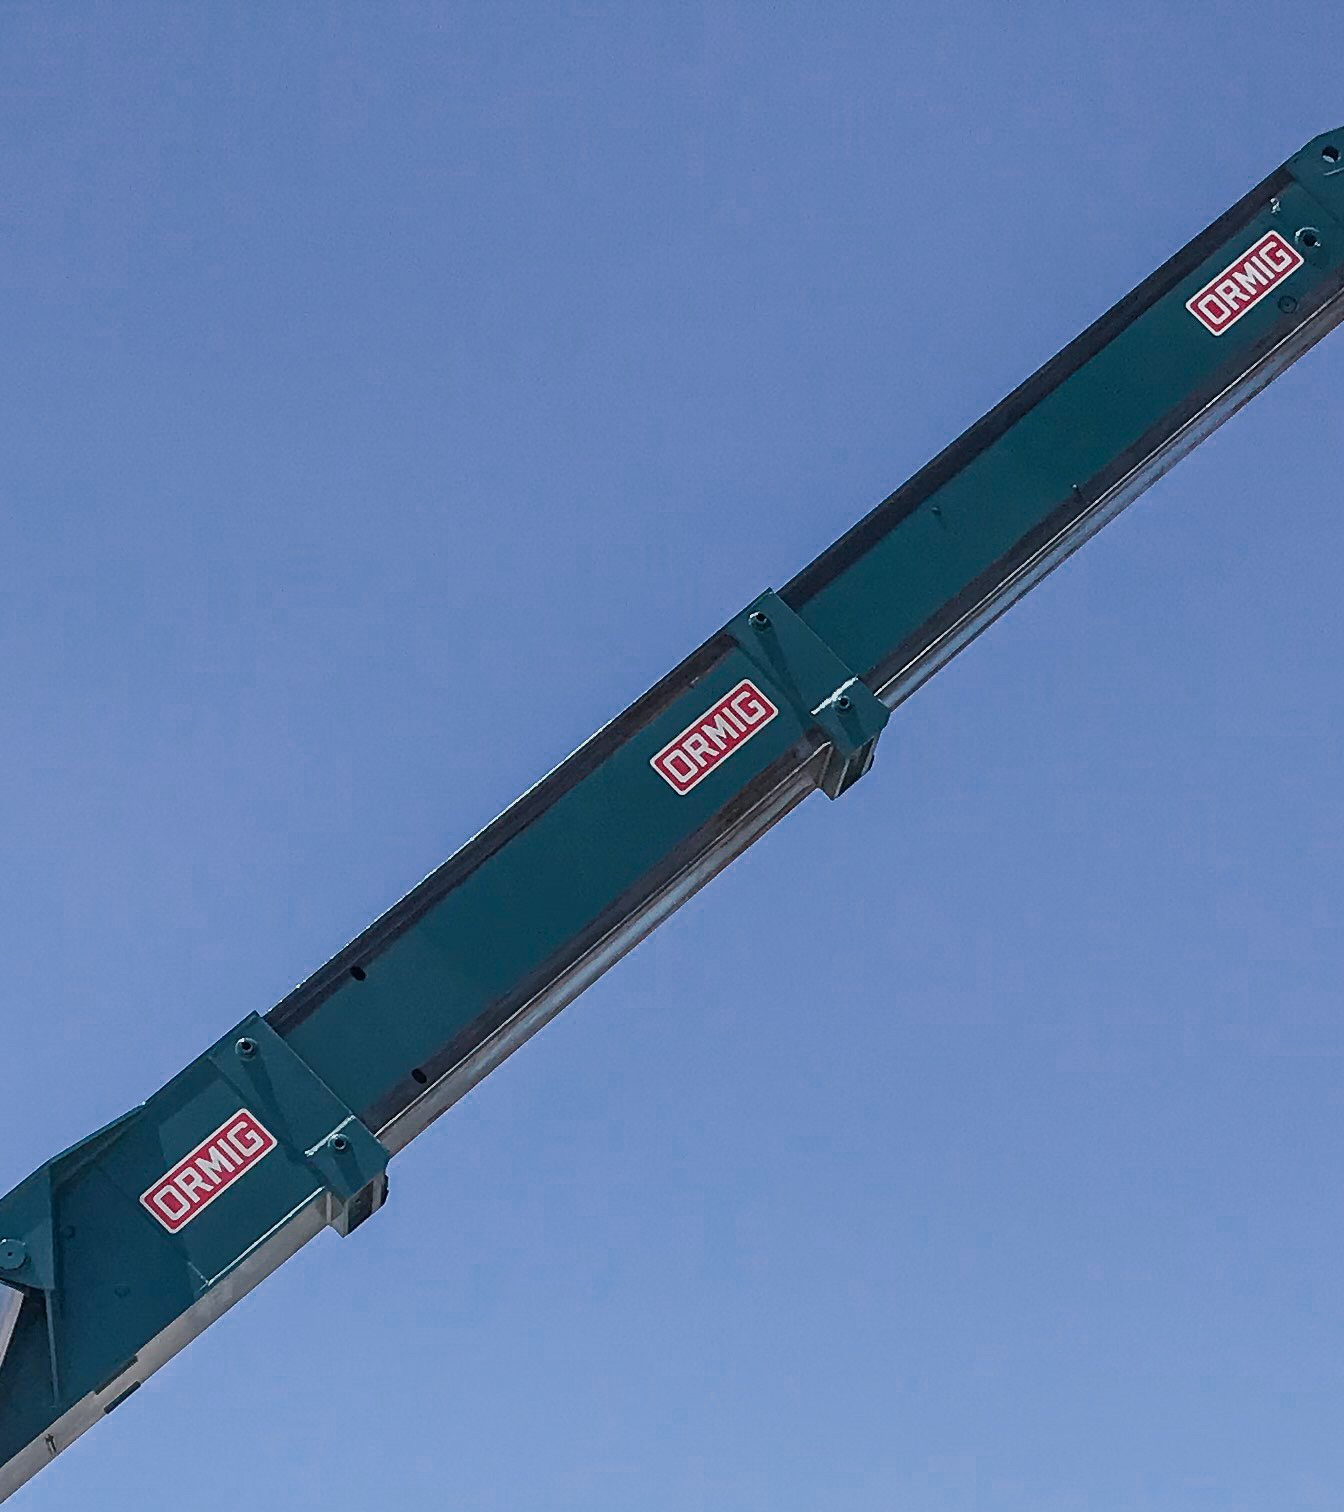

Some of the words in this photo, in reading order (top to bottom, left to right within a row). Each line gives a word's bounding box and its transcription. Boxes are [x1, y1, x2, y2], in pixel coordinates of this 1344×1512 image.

[1198, 240, 1293, 325] ORMIG
[662, 691, 766, 785] ORMIG
[152, 1119, 266, 1222] ORMIG
